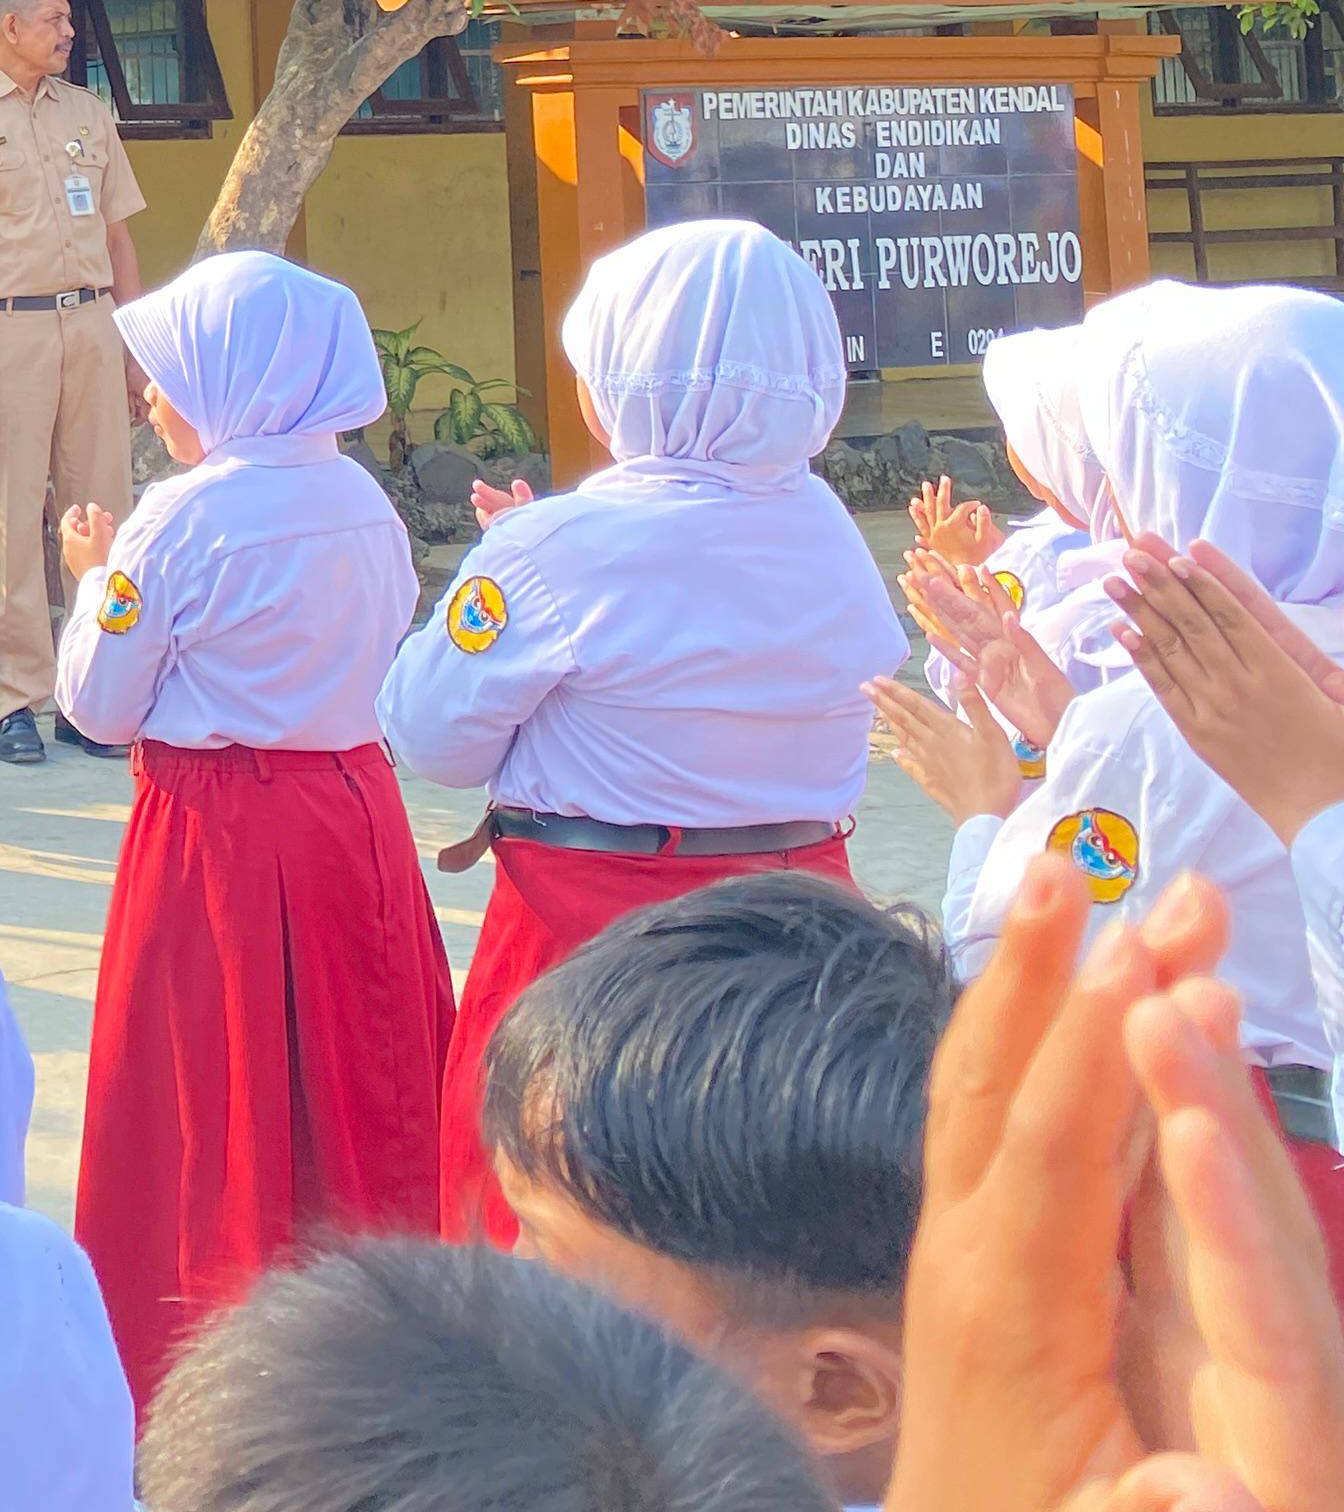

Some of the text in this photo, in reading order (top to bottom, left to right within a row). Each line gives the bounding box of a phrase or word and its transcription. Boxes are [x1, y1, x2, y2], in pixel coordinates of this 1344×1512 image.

[702, 86, 1065, 120] PEMERINTAH KABUPATEN KENDAL
[785, 118, 1001, 150] DINAS ENDIDIKAN
[875, 152, 926, 179] DAN
[815, 183, 984, 214] KEBUDAYAAN
[875, 231, 1082, 289] PURWOREJO
